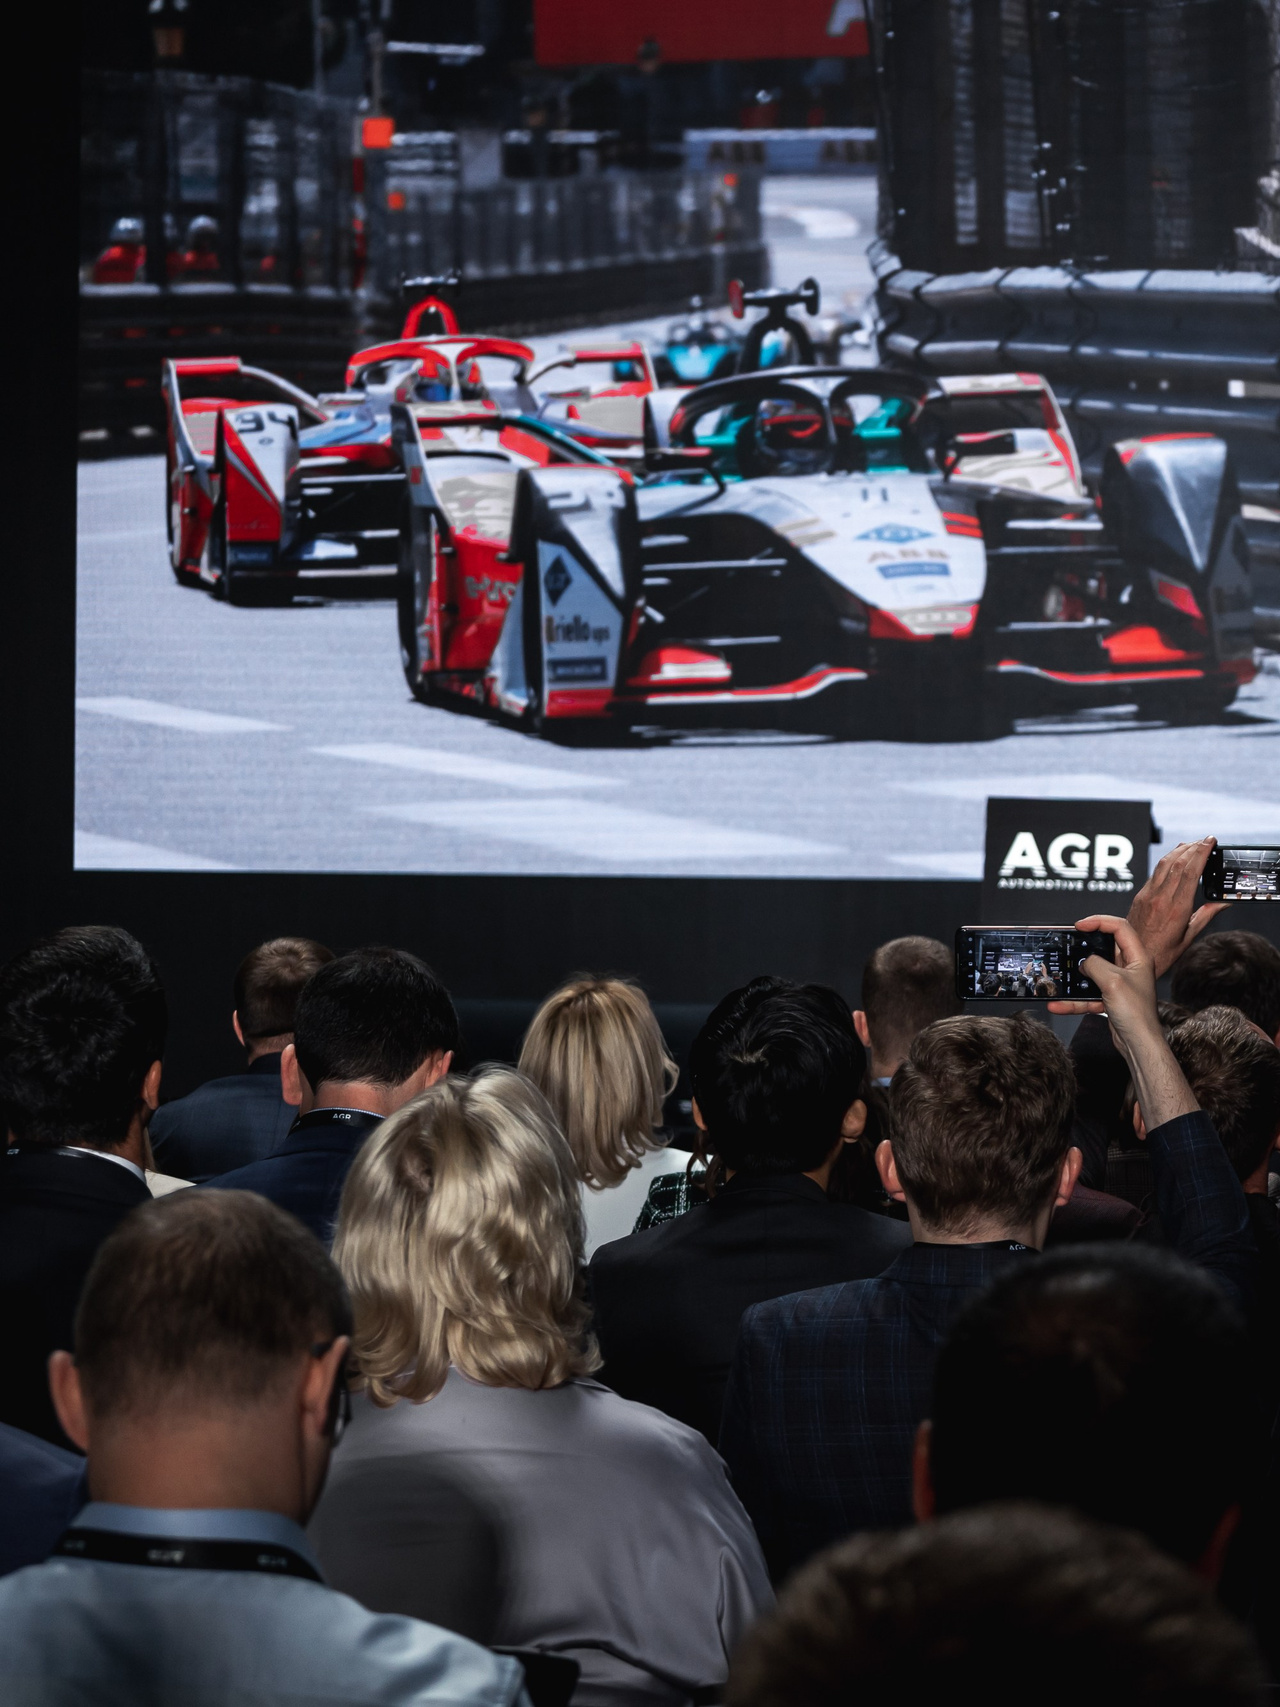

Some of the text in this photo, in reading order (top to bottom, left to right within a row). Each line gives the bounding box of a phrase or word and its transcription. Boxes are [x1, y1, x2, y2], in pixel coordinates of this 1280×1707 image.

[998, 831, 1134, 880] AGR
[998, 878, 1135, 893] AUTOMOTIVE GROUP
